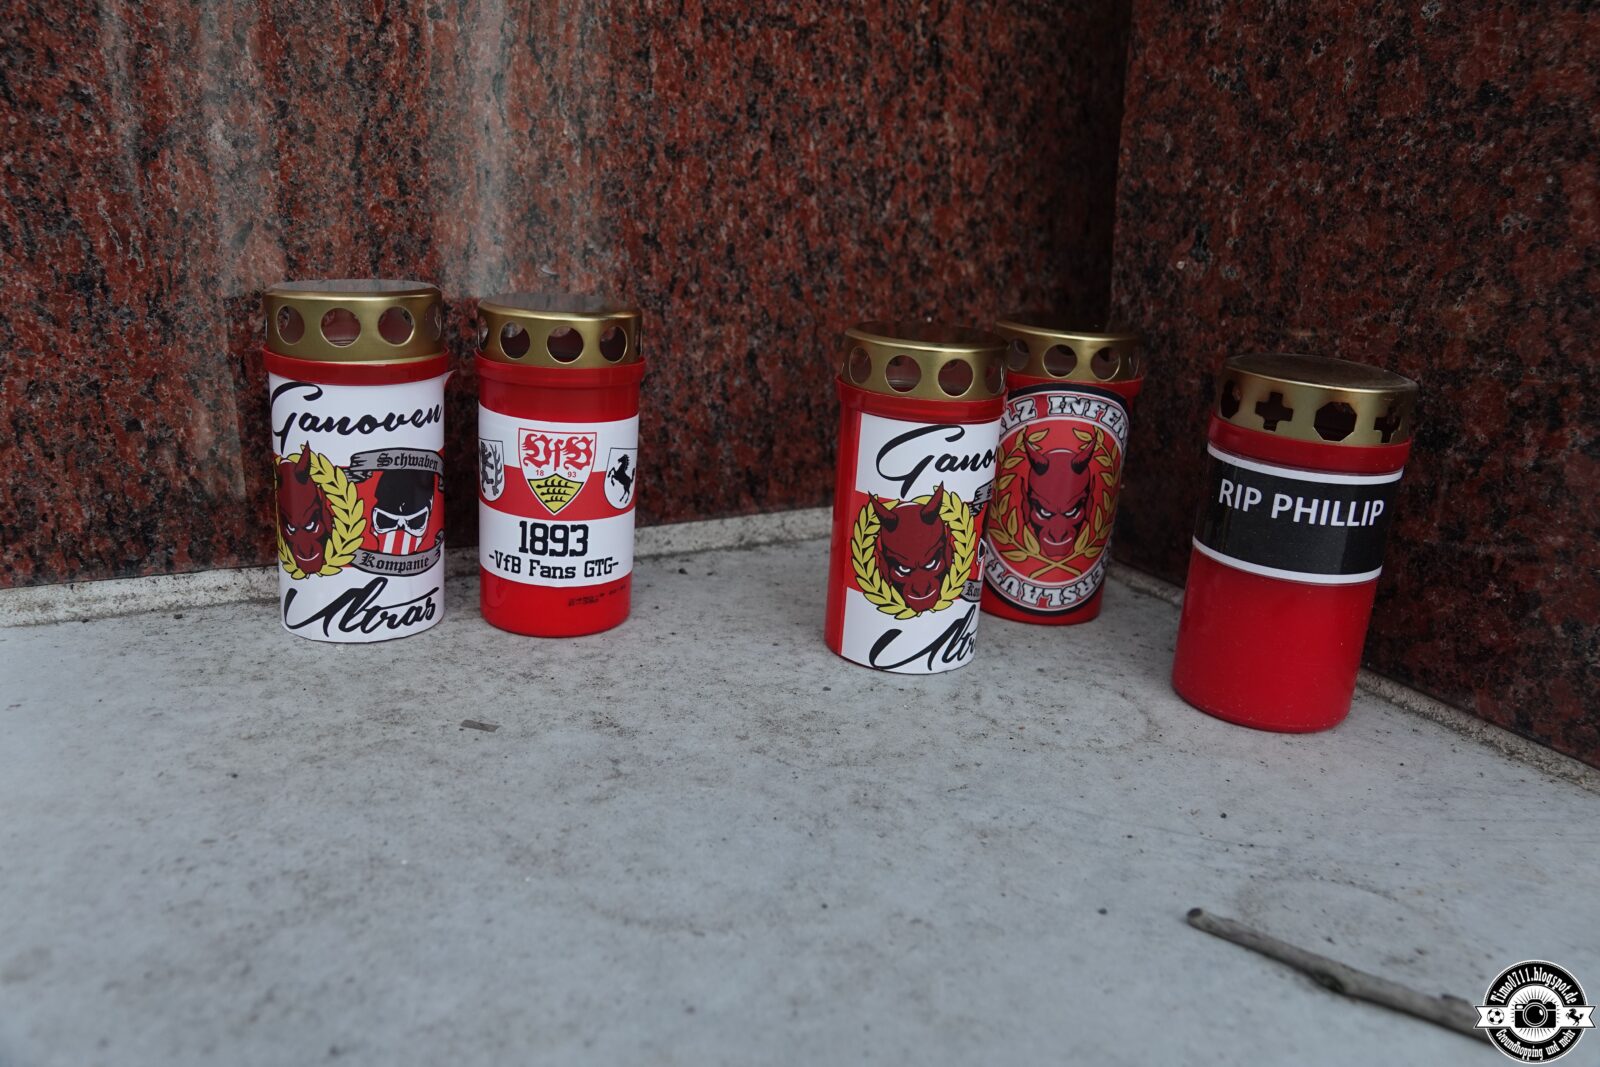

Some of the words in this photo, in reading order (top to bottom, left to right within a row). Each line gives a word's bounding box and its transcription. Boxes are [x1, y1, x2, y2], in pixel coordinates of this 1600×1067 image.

[271, 381, 442, 455] Ganoven
[376, 452, 439, 470] Schwaben
[521, 432, 594, 472] VfB
[535, 469, 545, 477] 18
[567, 471, 577, 479] 93
[1218, 478, 1263, 512] RIP
[1271, 493, 1385, 527] PHILLIP
[518, 520, 589, 557] 1893
[359, 551, 430, 573] Kompanie
[529, 558, 577, 579] Fans
[283, 576, 440, 638] Ultras
